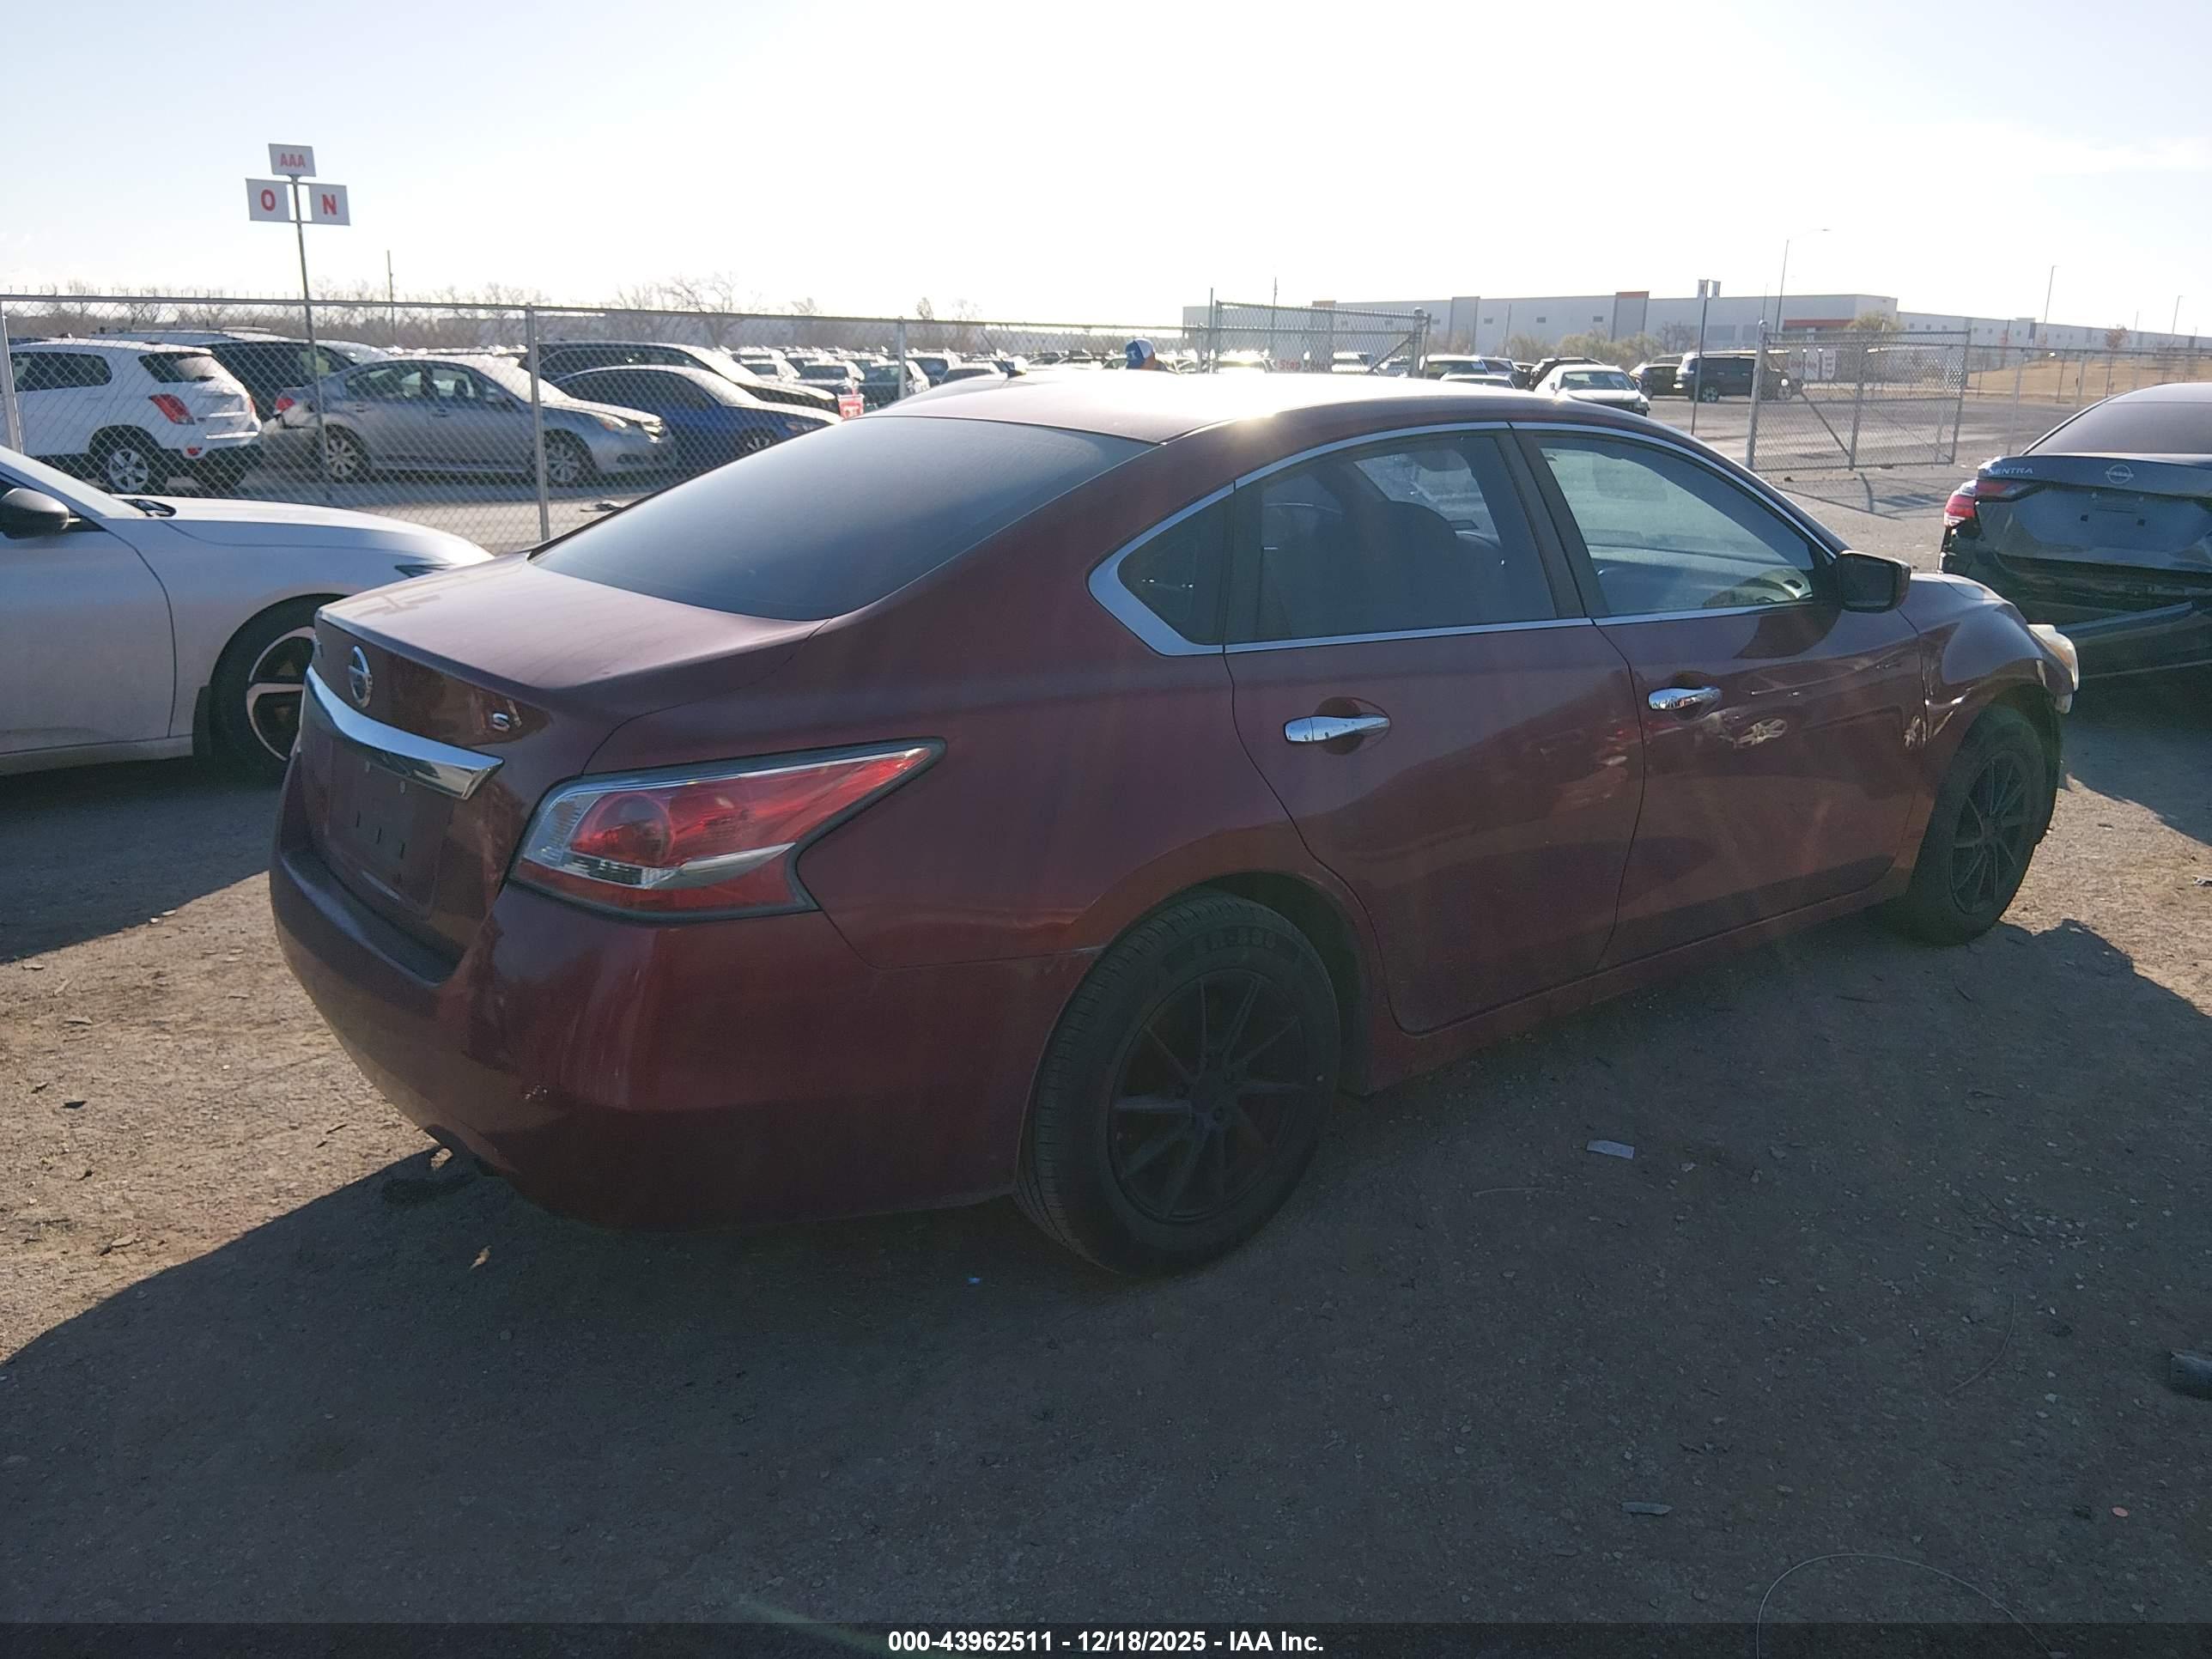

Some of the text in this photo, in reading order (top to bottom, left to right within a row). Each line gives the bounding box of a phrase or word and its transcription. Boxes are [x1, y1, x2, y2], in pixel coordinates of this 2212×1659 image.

[280, 153, 306, 168] AAA
[322, 194, 337, 216] N
[1988, 466, 2033, 476] SENTRA
